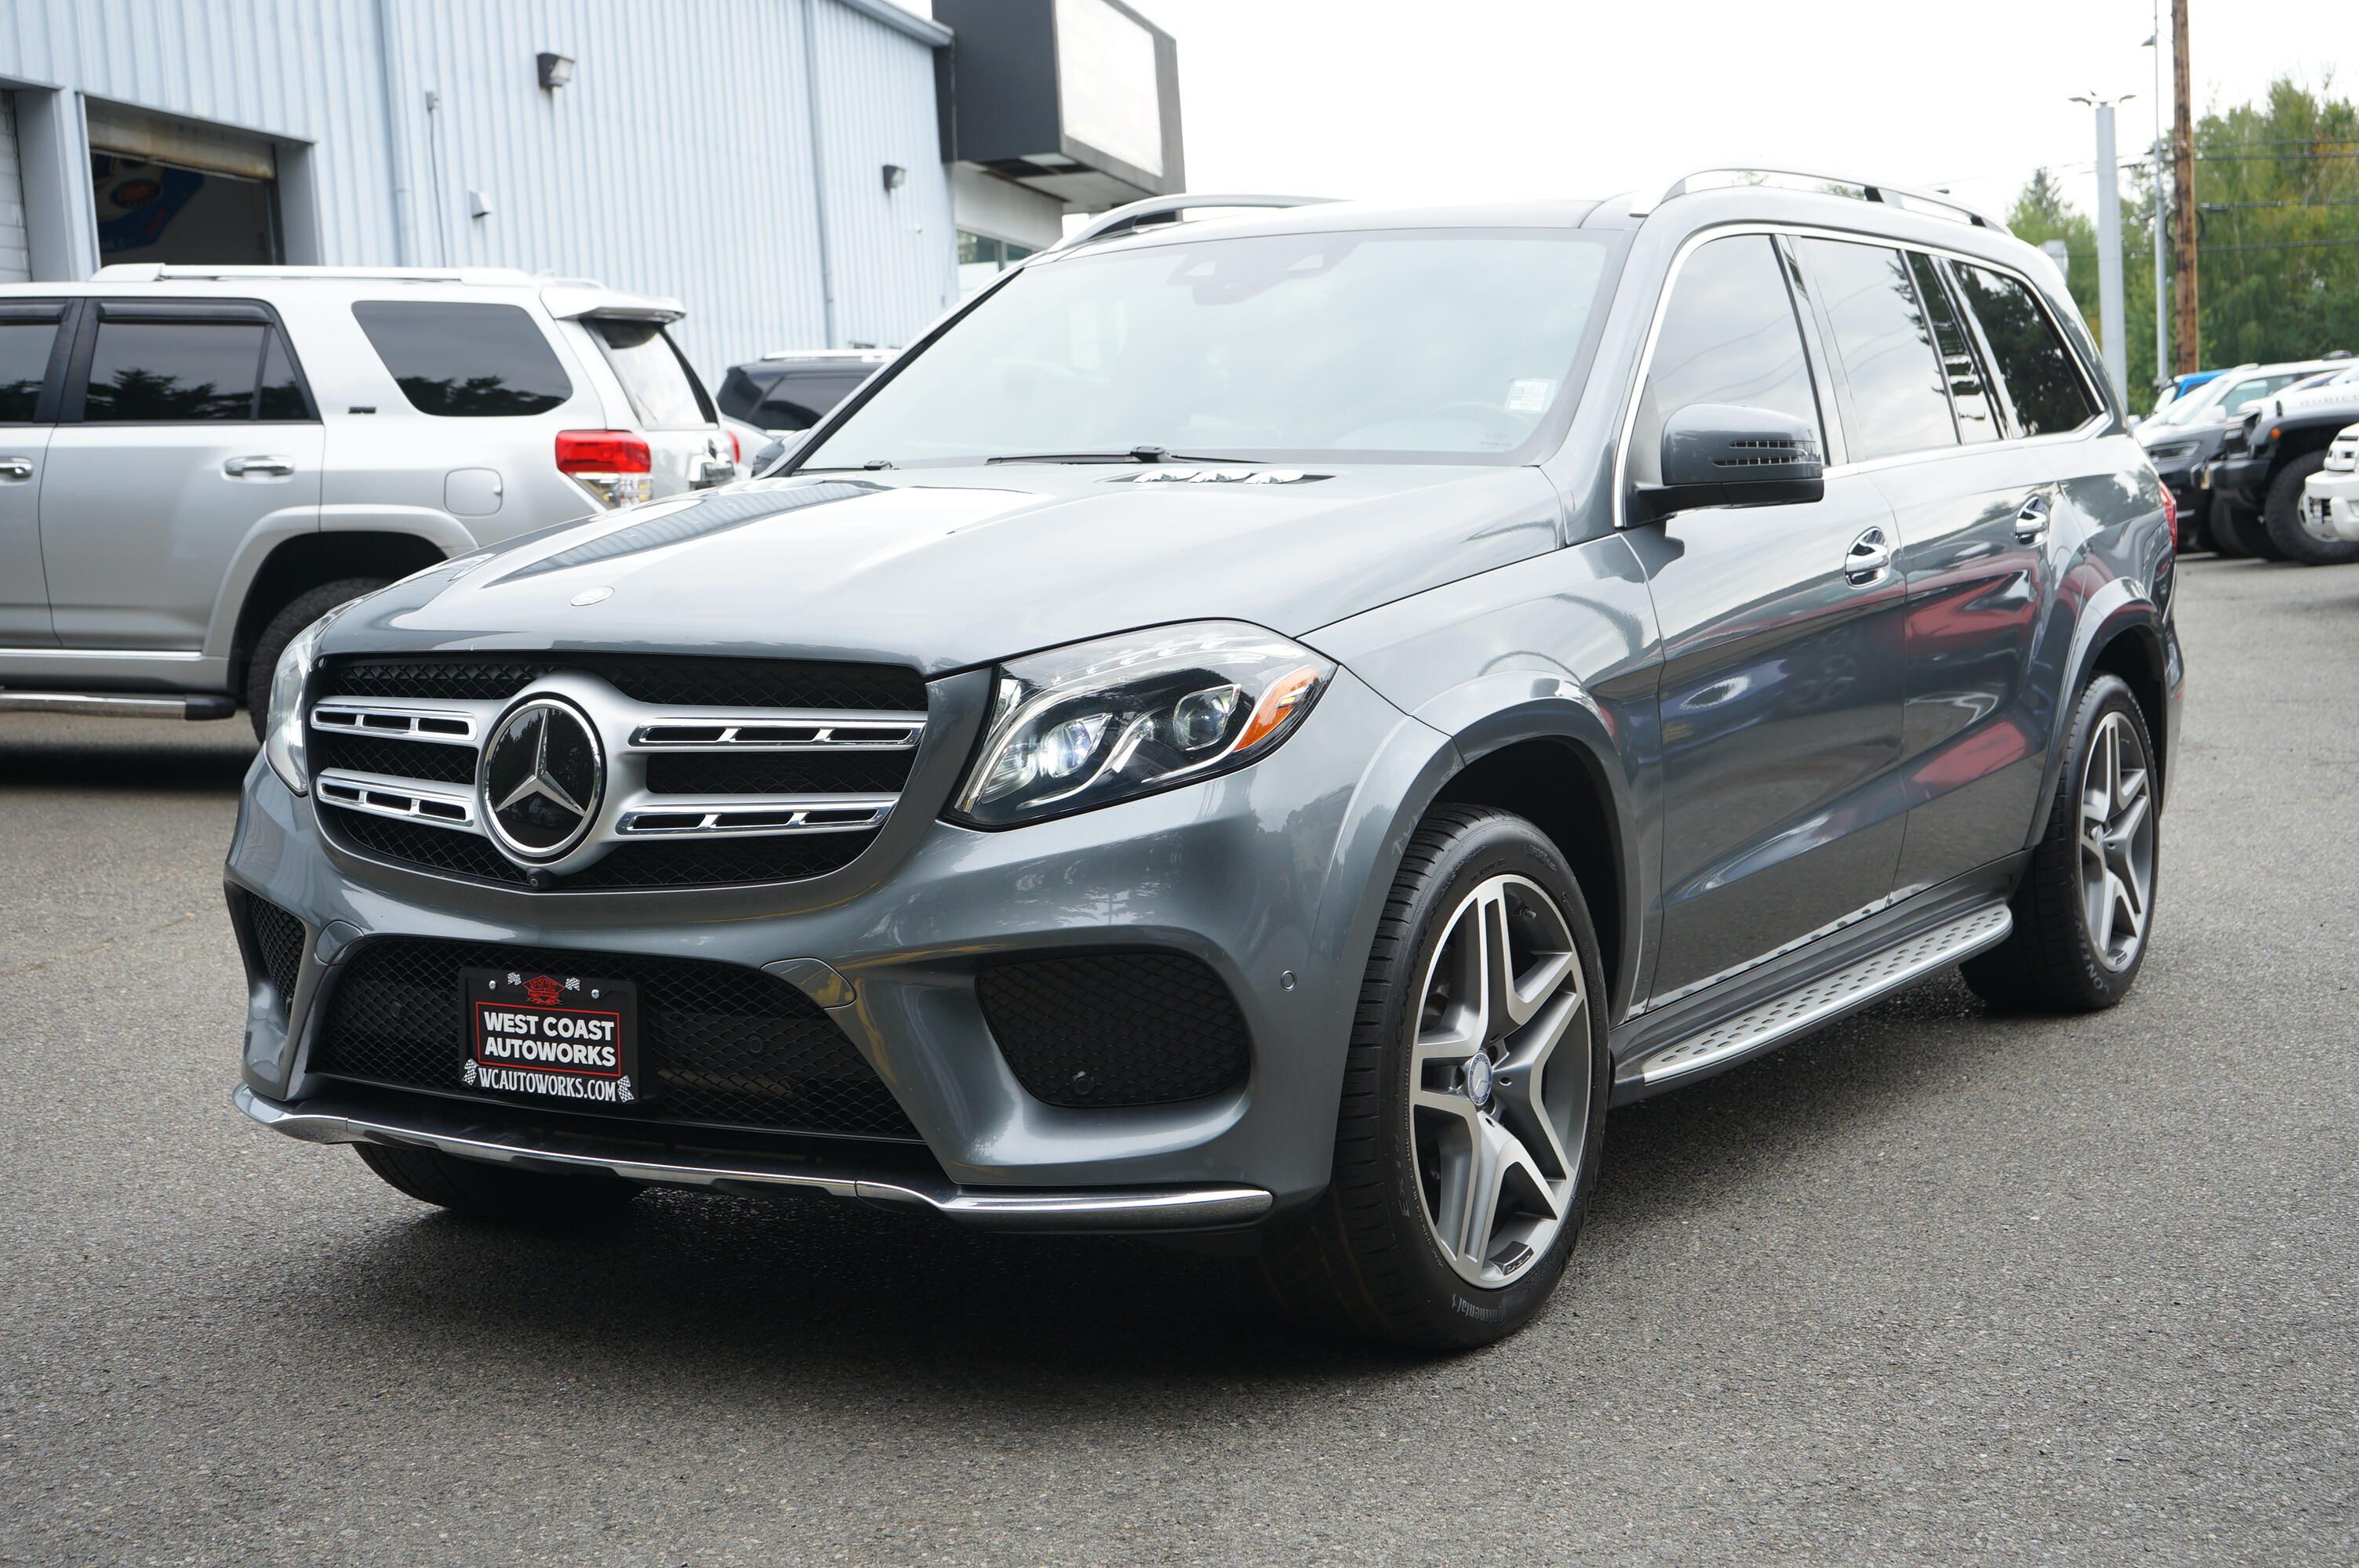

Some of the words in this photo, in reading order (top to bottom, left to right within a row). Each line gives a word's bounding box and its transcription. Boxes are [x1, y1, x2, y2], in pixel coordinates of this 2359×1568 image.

[484, 1011, 539, 1035] WEST
[543, 1016, 615, 1041] COAST
[485, 1036, 616, 1067] AUTOWORKS
[478, 1067, 616, 1102] WCAUTOWORKS.COM
